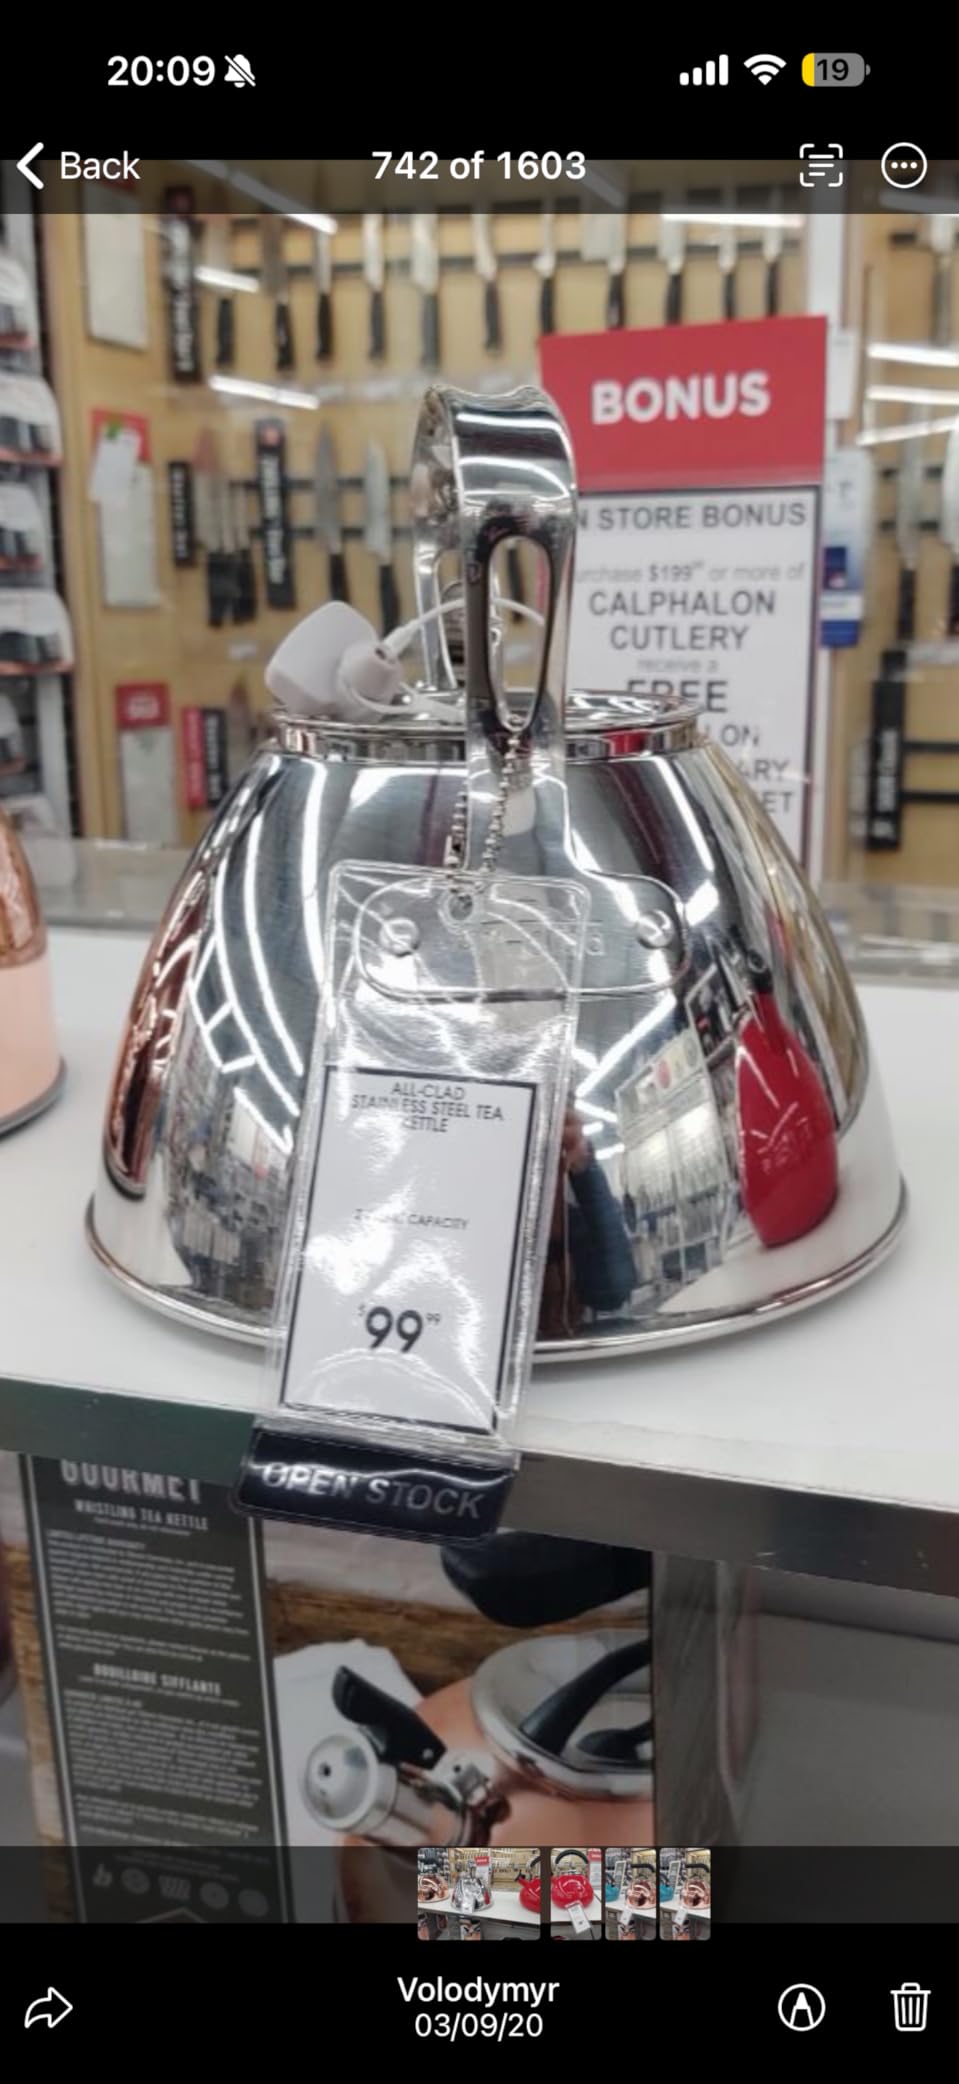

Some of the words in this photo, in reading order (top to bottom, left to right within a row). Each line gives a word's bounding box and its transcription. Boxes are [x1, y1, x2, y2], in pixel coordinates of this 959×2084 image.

[591, 370, 771, 425] BONUS
[596, 505, 692, 531] STORE
[702, 502, 807, 528] BONUS
[576, 564, 641, 583] urchase
[709, 567, 728, 582] or
[733, 567, 782, 581] more
[787, 562, 805, 581] of
[589, 590, 777, 617] CALPHALON
[609, 625, 749, 651] CUTLERY
[637, 659, 702, 674] receive
[708, 660, 718, 673] a
[391, 1082, 465, 1100] ALL-CLAD
[431, 1101, 471, 1118] STEEL
[476, 1104, 504, 1121] TEA
[408, 1213, 469, 1231] CAPACITY
[262, 1462, 360, 1499] OPEN
[365, 1478, 486, 1519] STOCK
[140, 1507, 162, 1524] TEA
[165, 1511, 209, 1531] KETTLE
